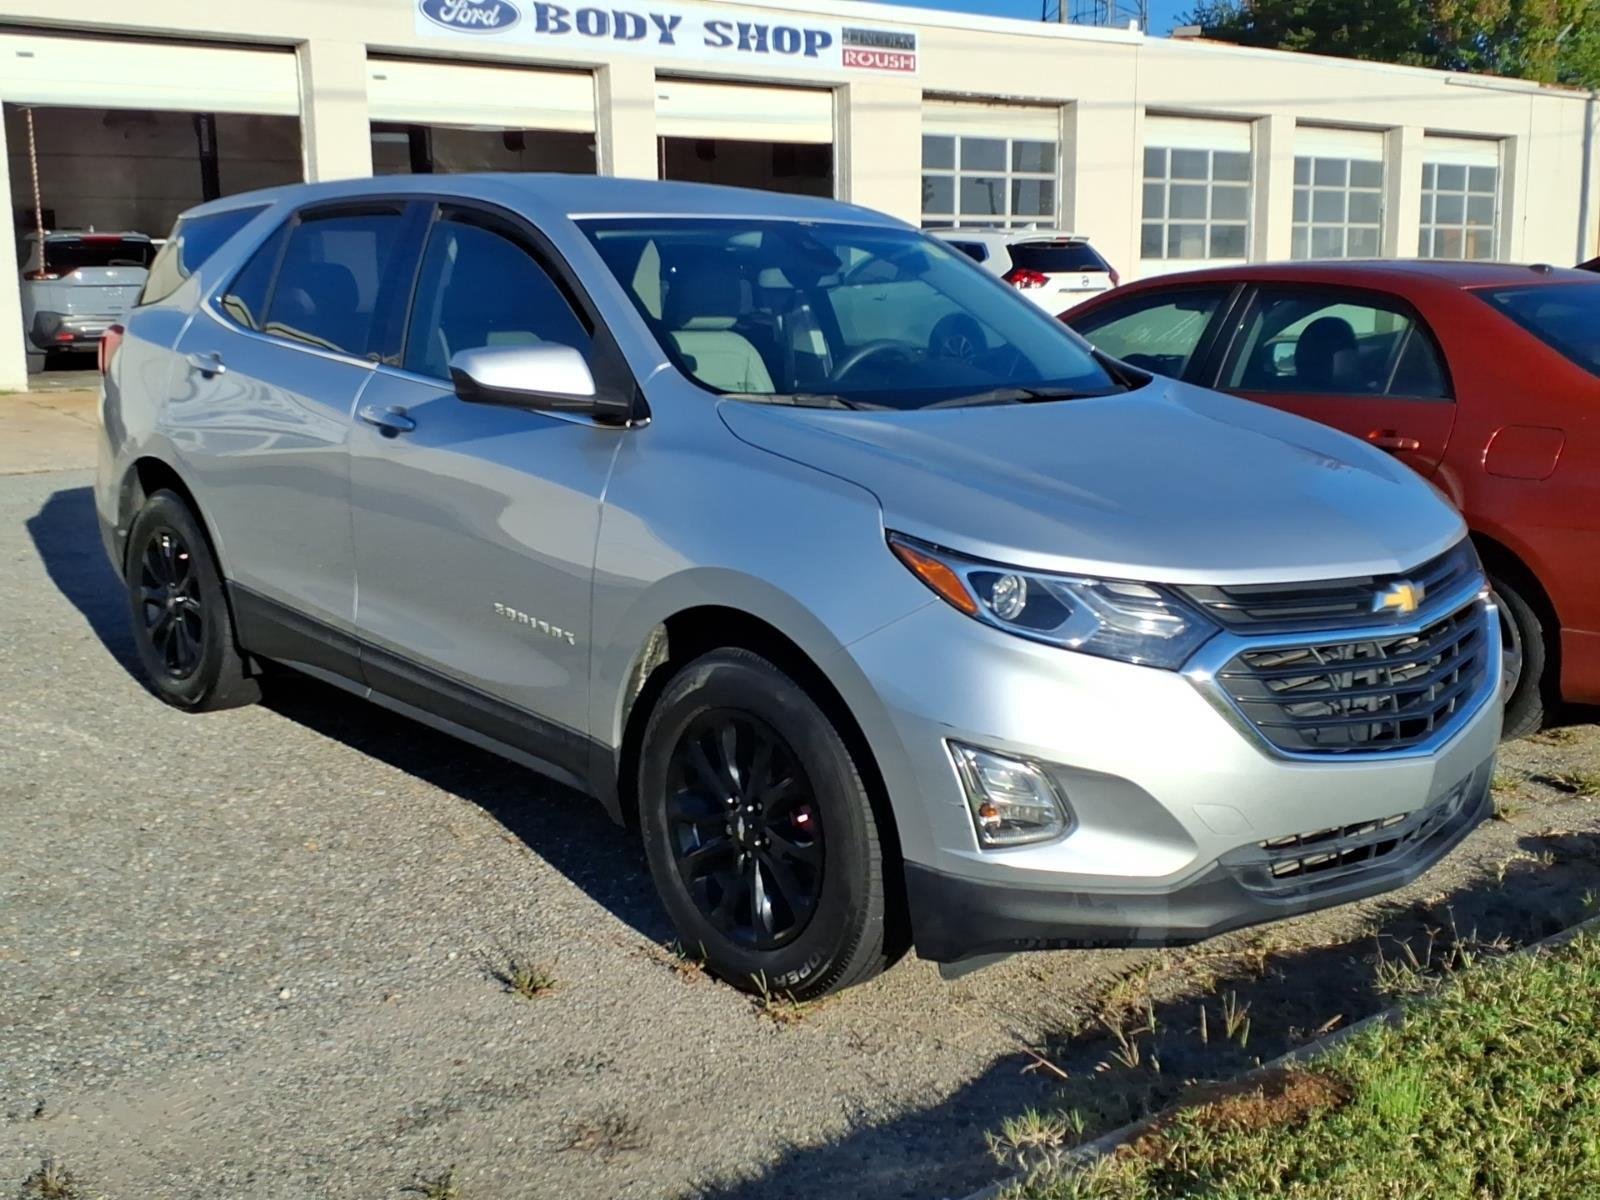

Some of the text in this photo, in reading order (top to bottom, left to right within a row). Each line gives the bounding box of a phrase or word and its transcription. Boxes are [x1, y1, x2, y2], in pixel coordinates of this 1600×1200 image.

[439, 0, 500, 26] Ford
[533, 1, 833, 58] BODY SHOP
[844, 50, 914, 70] ROUSH
